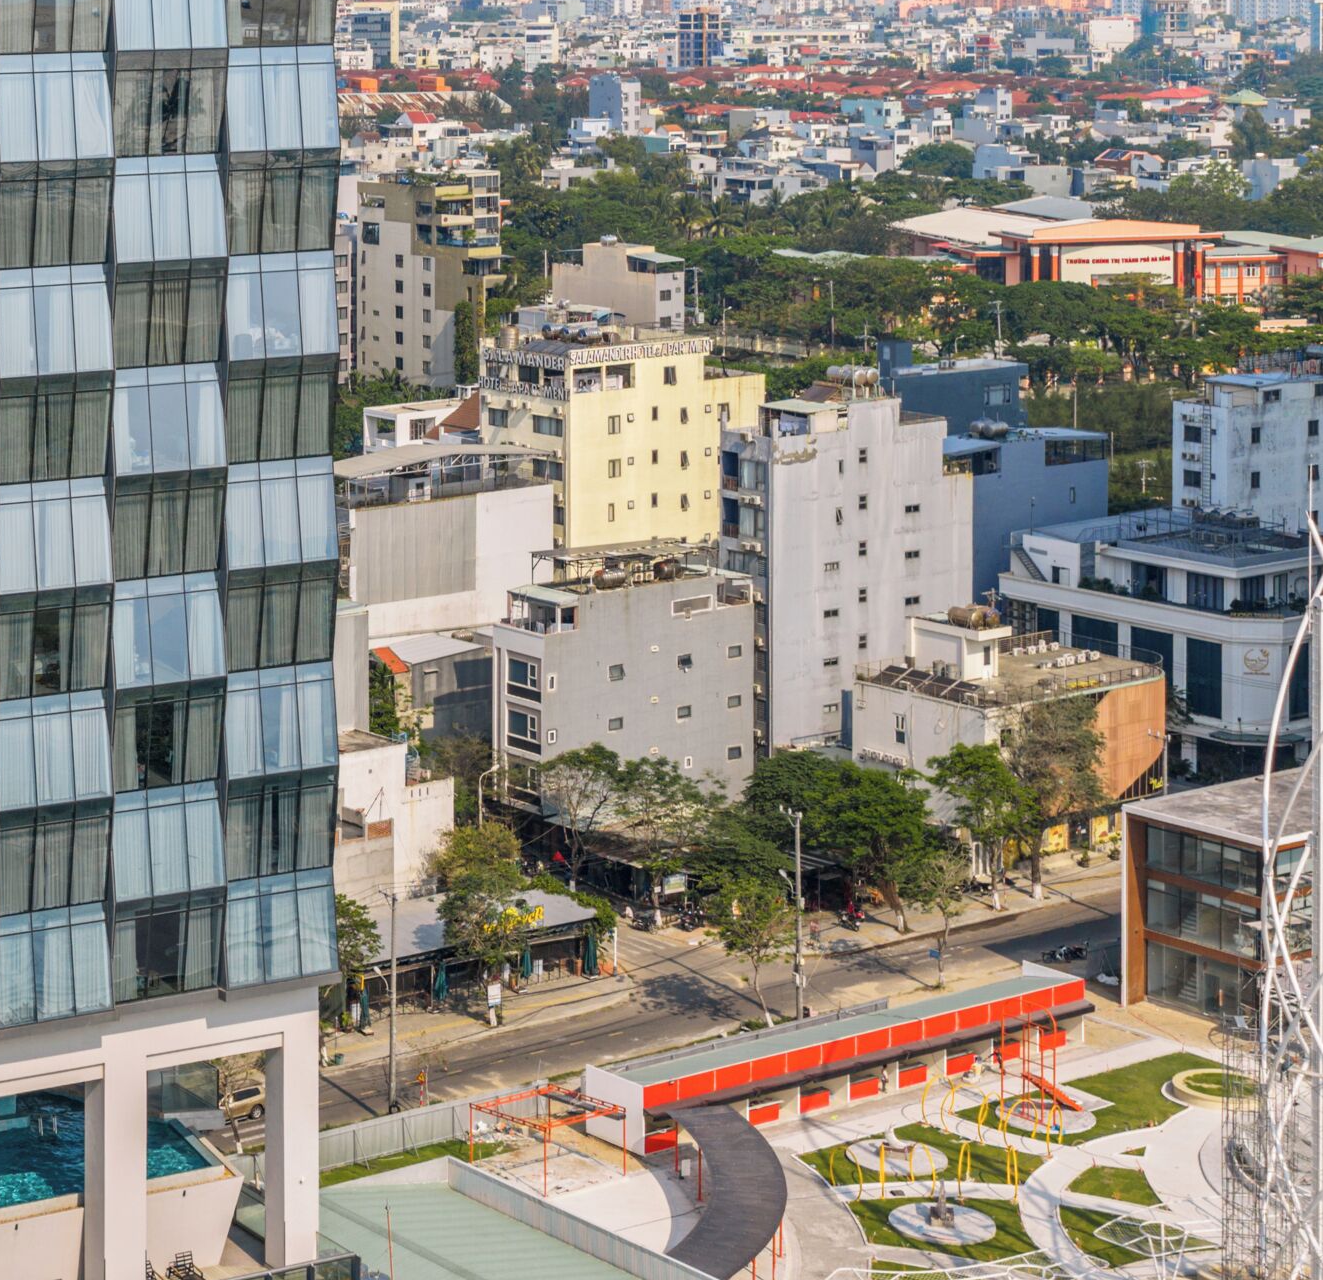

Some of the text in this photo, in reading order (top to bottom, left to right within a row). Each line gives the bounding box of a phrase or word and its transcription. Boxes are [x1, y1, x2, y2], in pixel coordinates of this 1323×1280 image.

[484, 348, 565, 370] SALAMANDER
[570, 346, 631, 365] SALAMANDER
[478, 376, 501, 391] HOTEL
[512, 382, 571, 401] APARMENT
